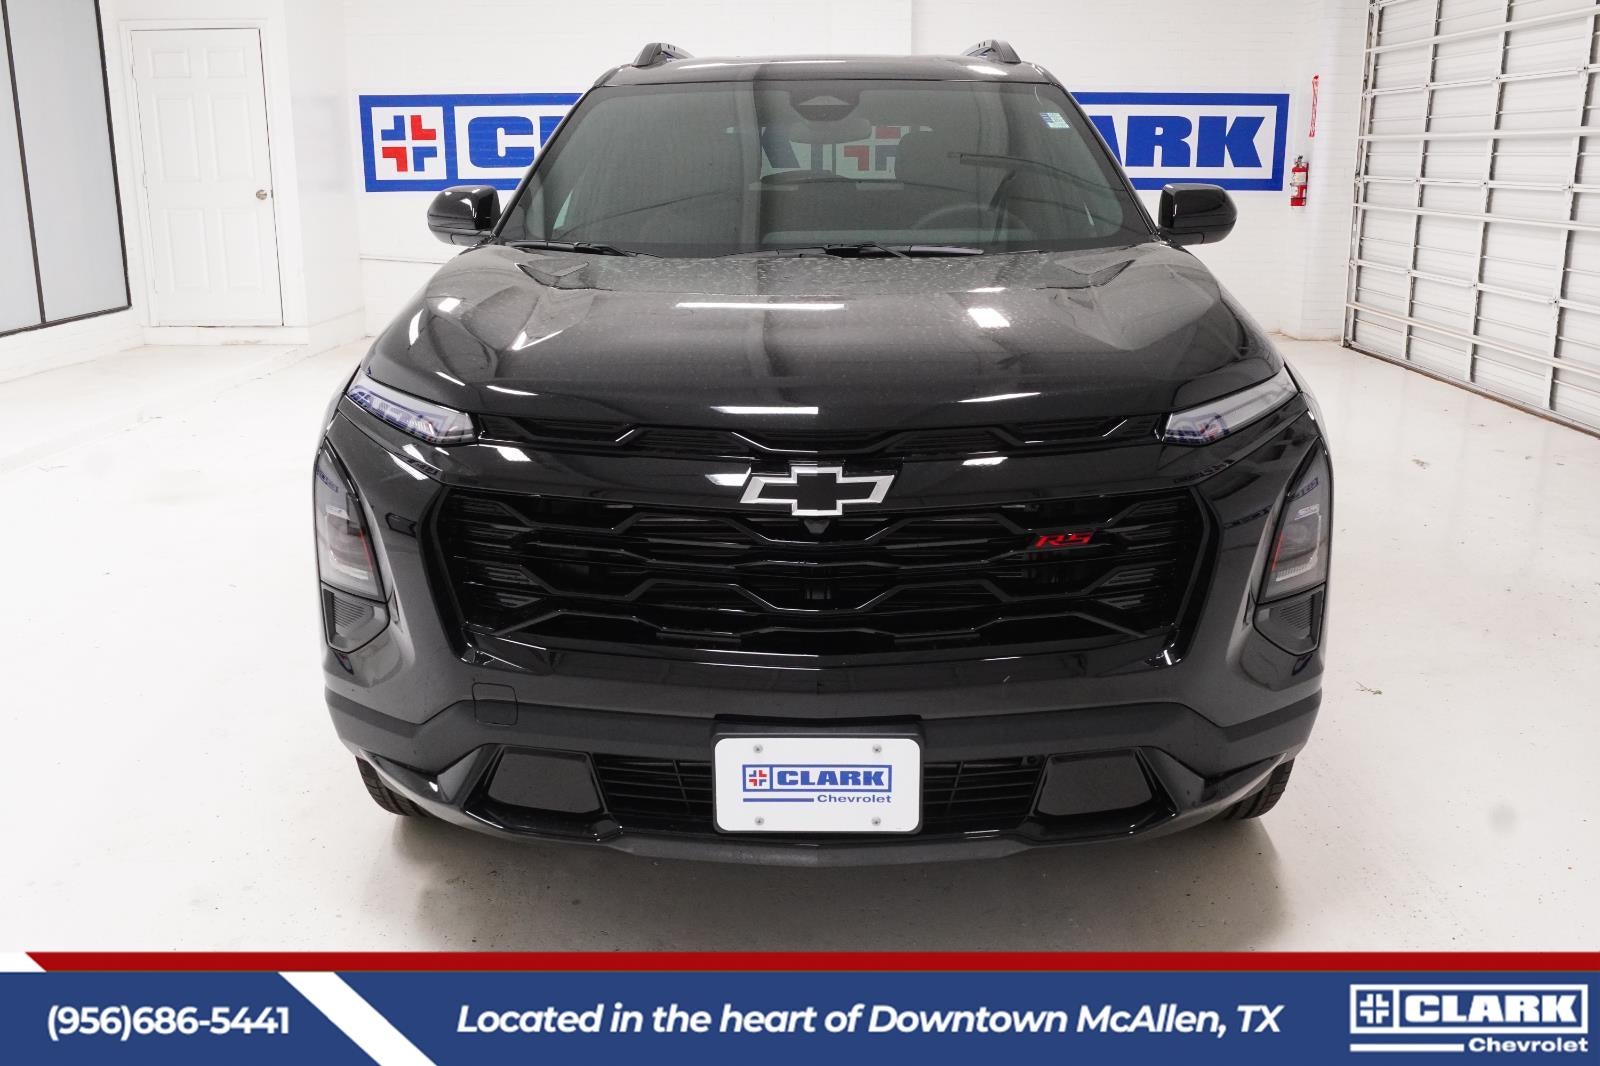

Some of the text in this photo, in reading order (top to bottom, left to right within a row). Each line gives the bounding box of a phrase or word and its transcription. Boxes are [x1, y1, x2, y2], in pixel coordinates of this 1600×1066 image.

[1034, 532, 1094, 549] RS
[777, 770, 884, 786] CLARK
[817, 794, 892, 803] Chevrolet
